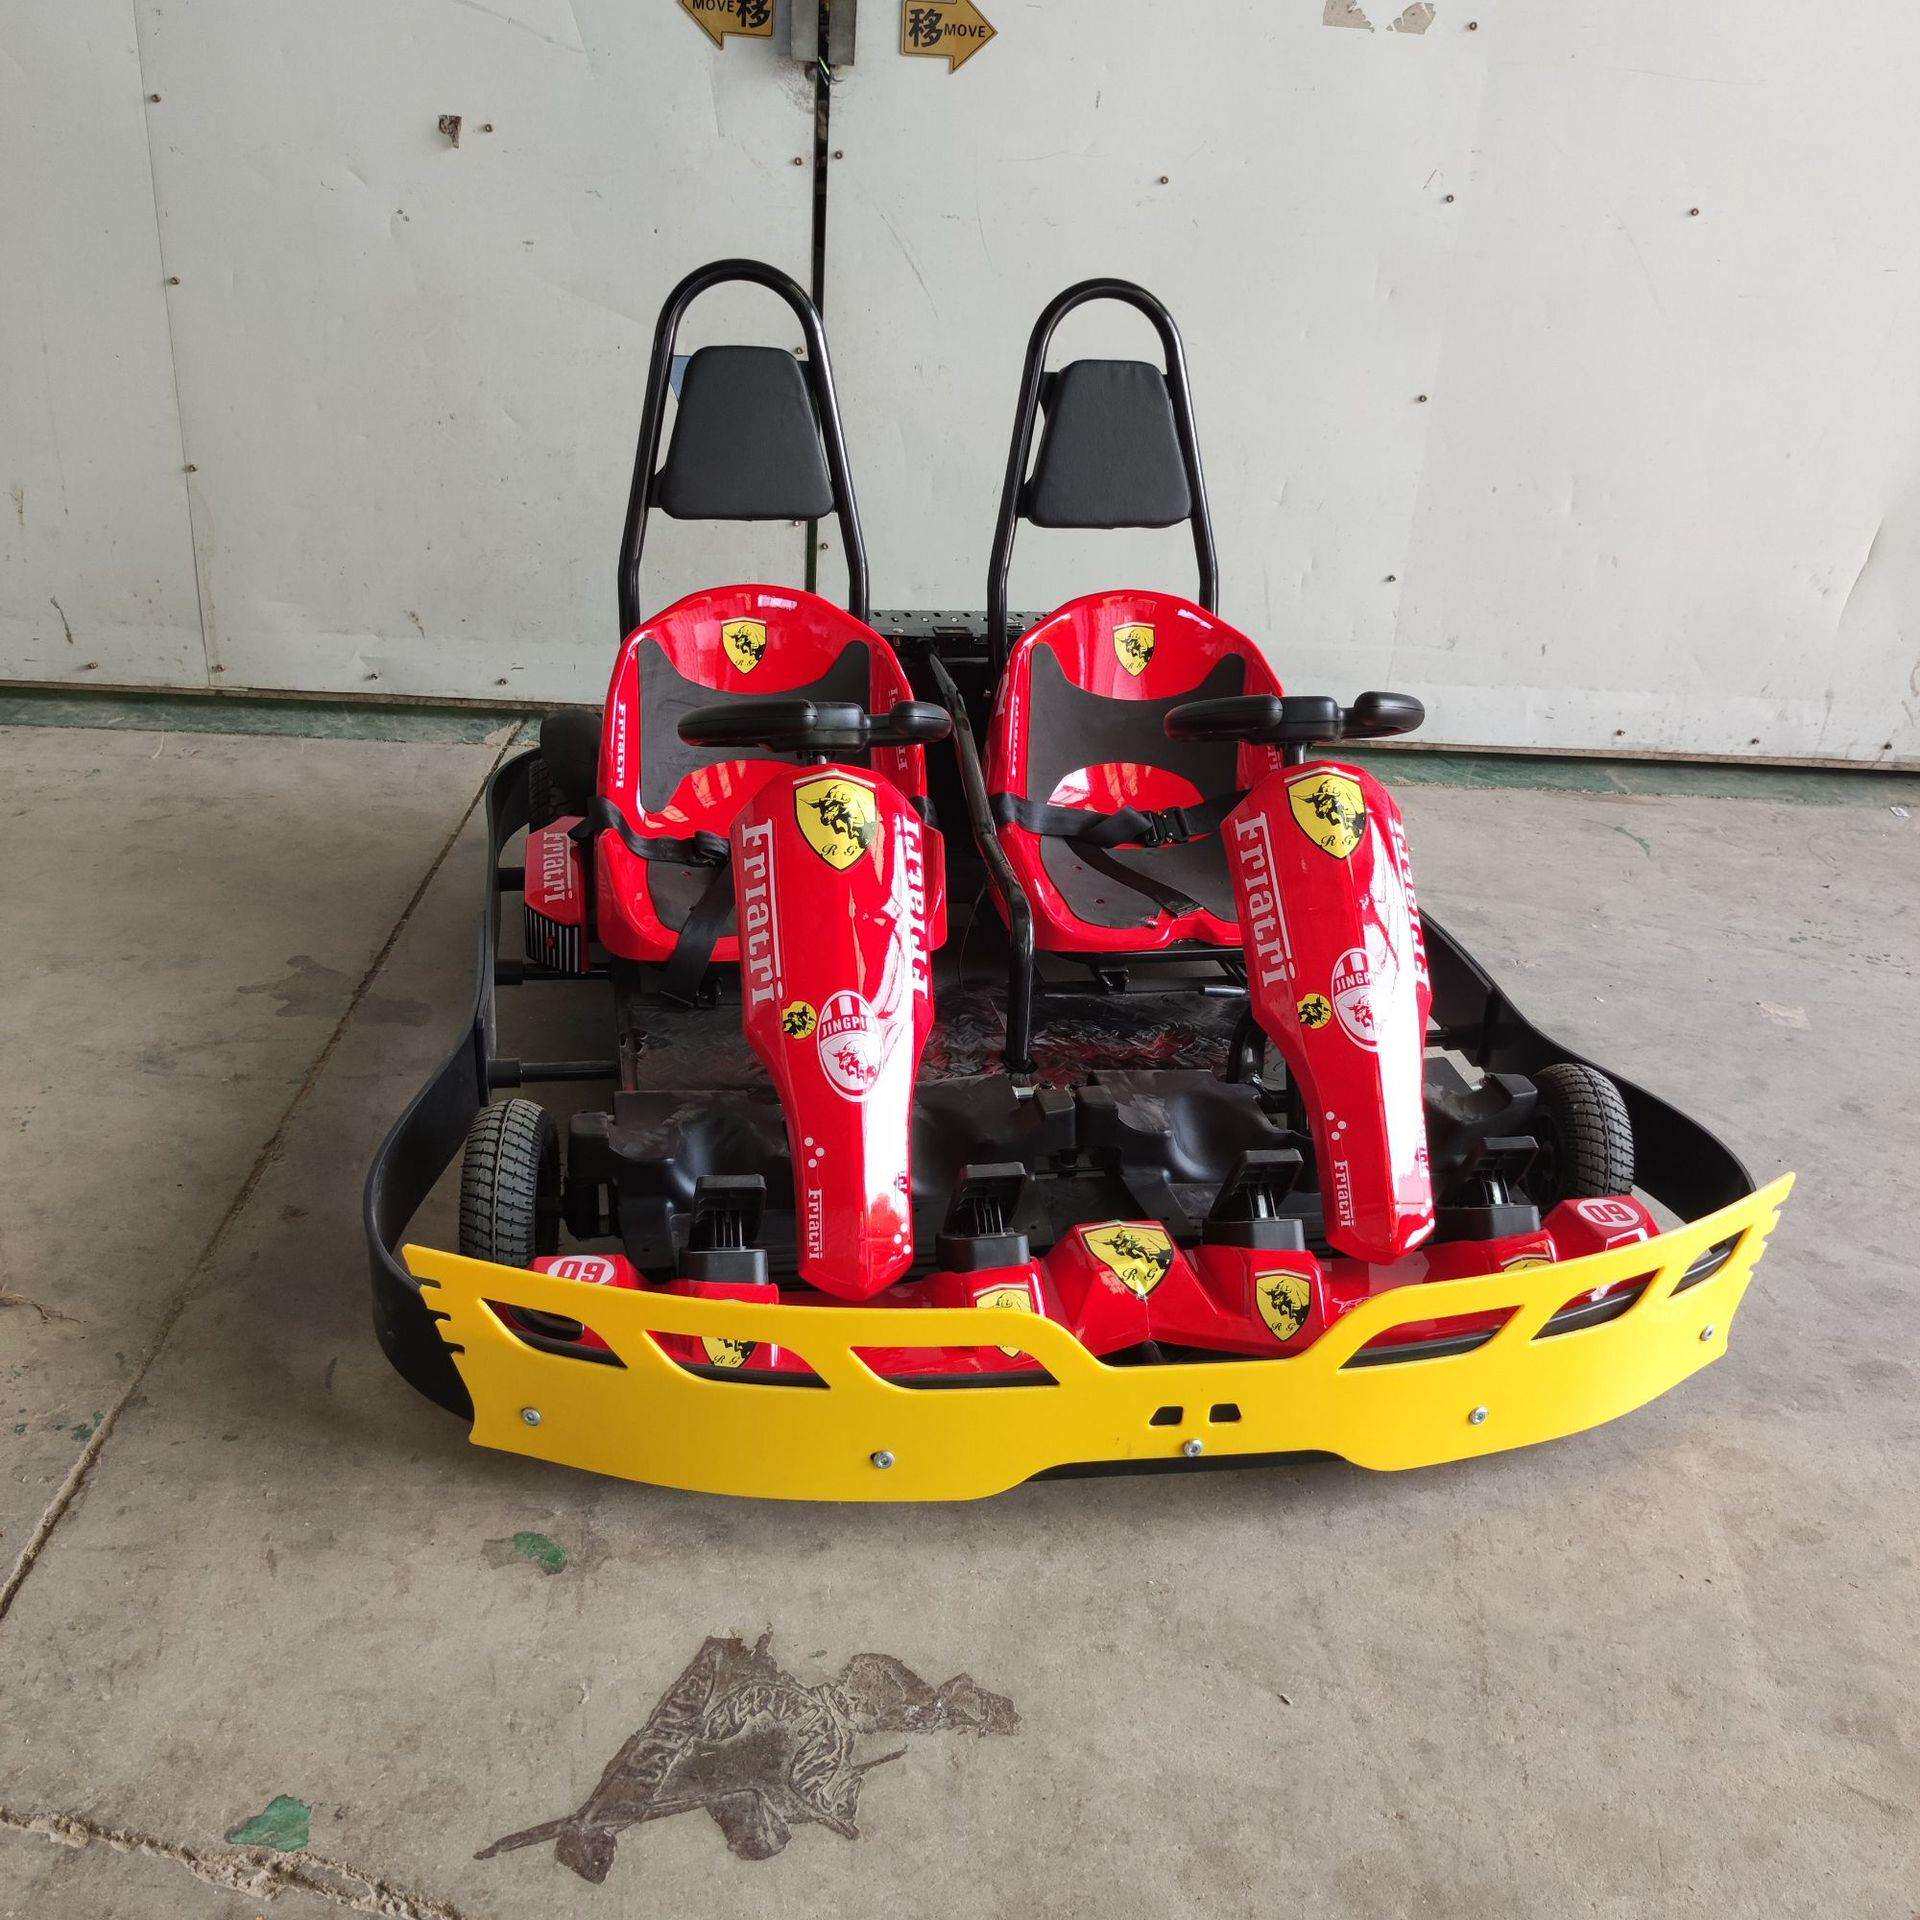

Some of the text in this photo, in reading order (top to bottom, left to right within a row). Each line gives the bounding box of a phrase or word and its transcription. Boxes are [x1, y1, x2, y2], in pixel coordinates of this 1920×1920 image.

[693, 0, 771, 28] MOVE 移
[908, 8, 986, 47] 移 MOVE
[822, 843, 838, 856] R
[1321, 834, 1336, 847] R
[1234, 810, 1296, 988] Friatri
[742, 817, 784, 1006] Friatri
[1583, 1203, 1634, 1223] 09
[557, 1261, 606, 1283] 09
[1122, 1267, 1138, 1281] R
